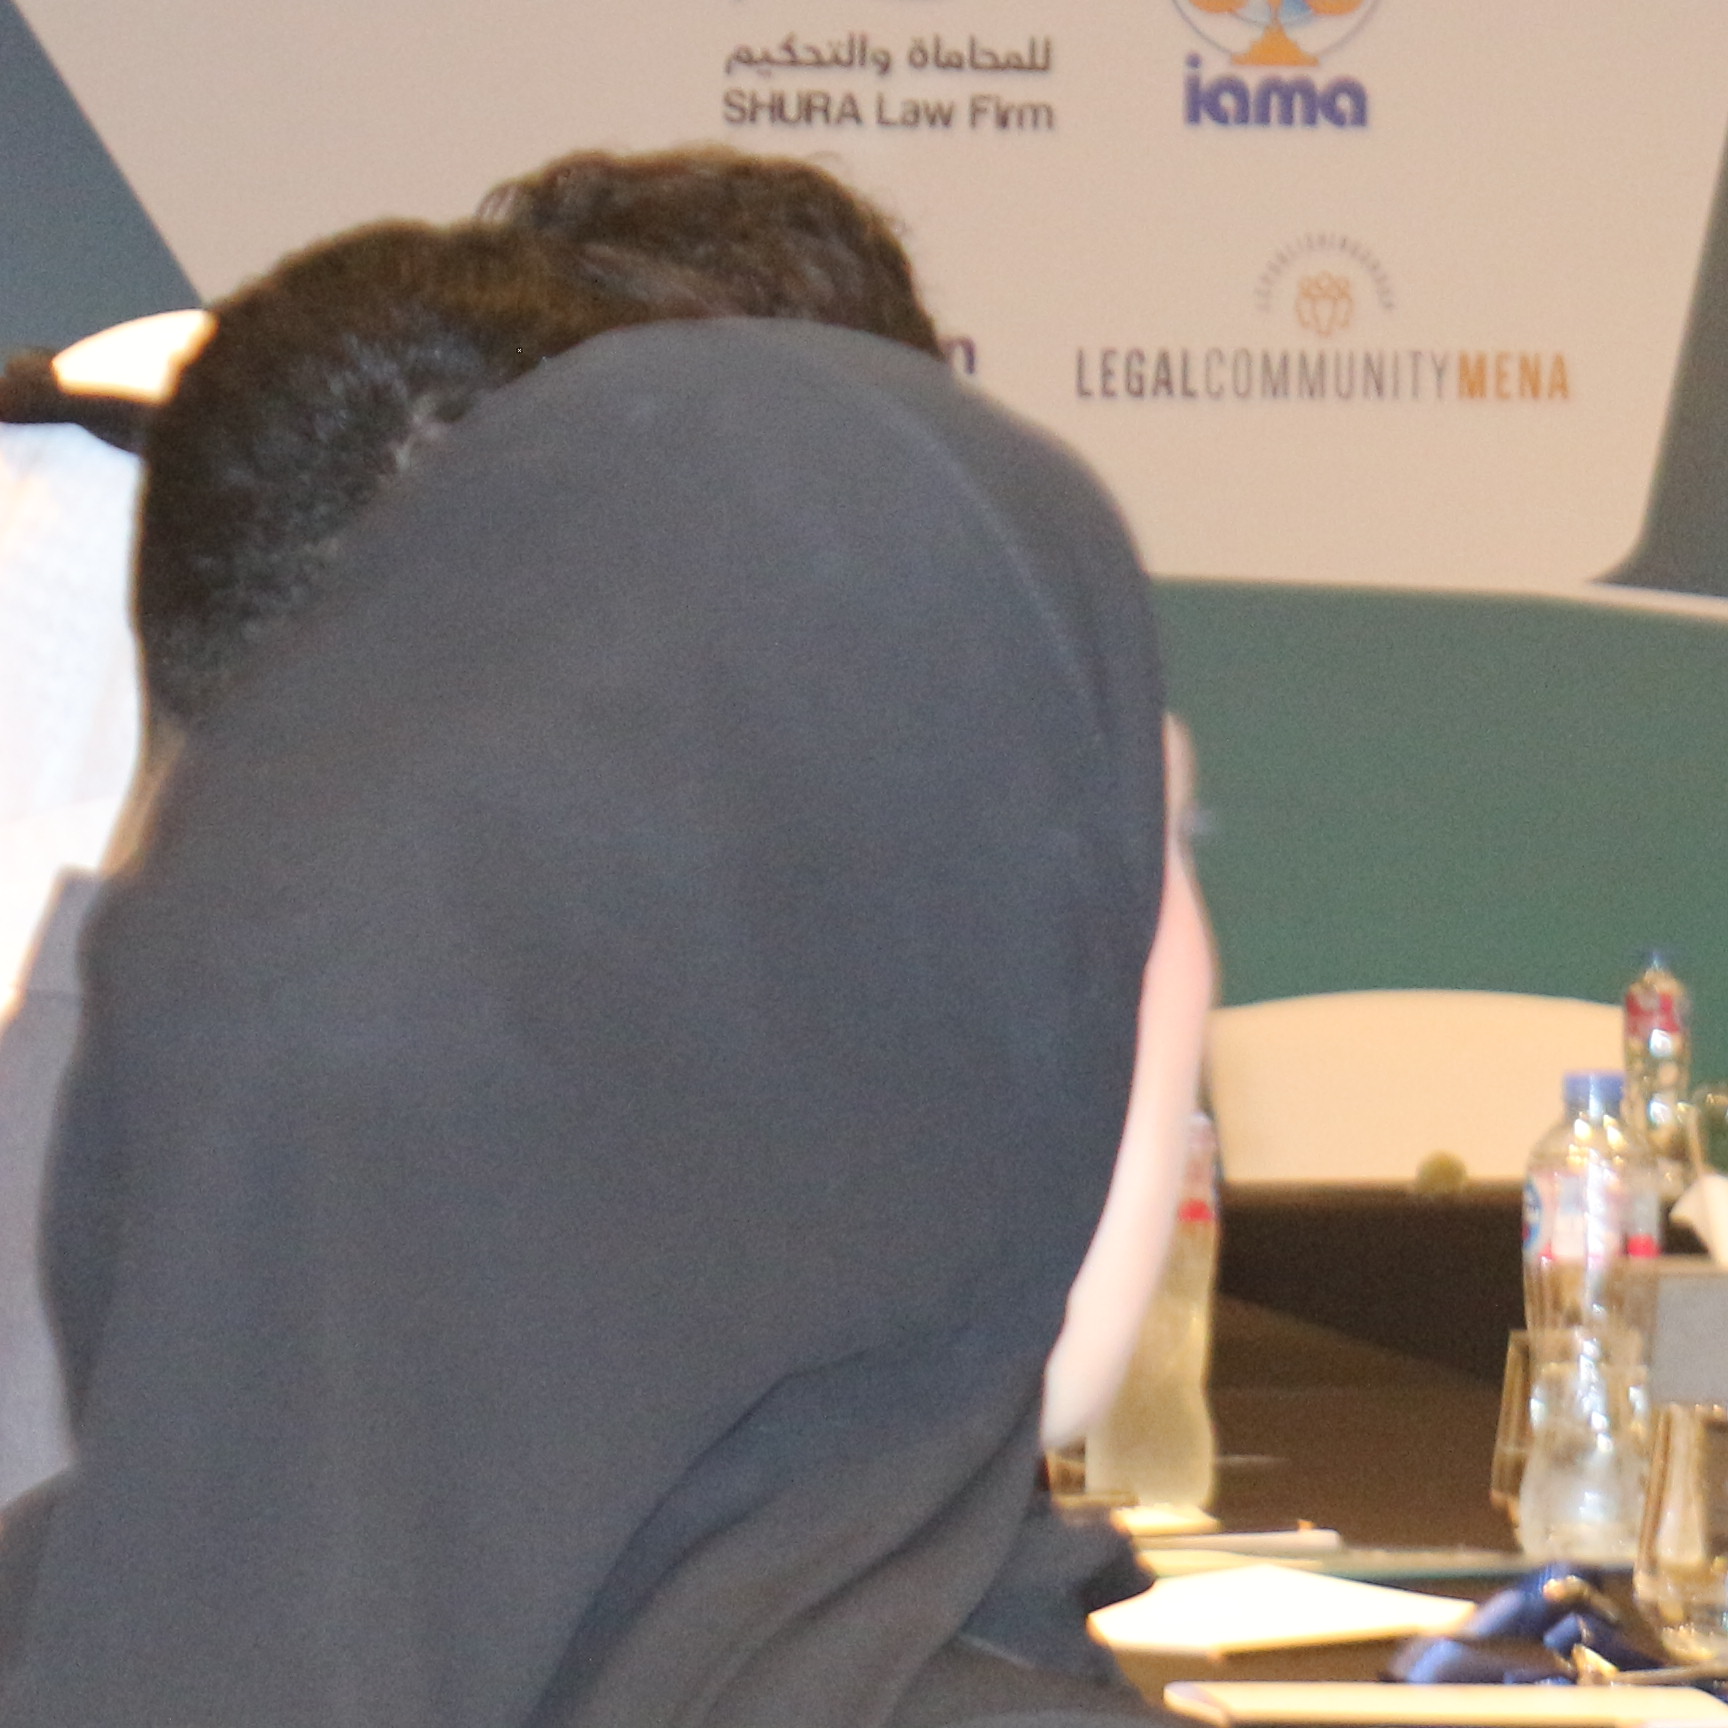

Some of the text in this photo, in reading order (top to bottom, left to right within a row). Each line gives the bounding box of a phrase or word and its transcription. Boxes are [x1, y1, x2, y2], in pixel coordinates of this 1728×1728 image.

[724, 30, 1053, 80] للمحاماة والتحكيم
[722, 89, 1056, 132] SHURA Law Firm
[1183, 53, 1369, 129] iama
